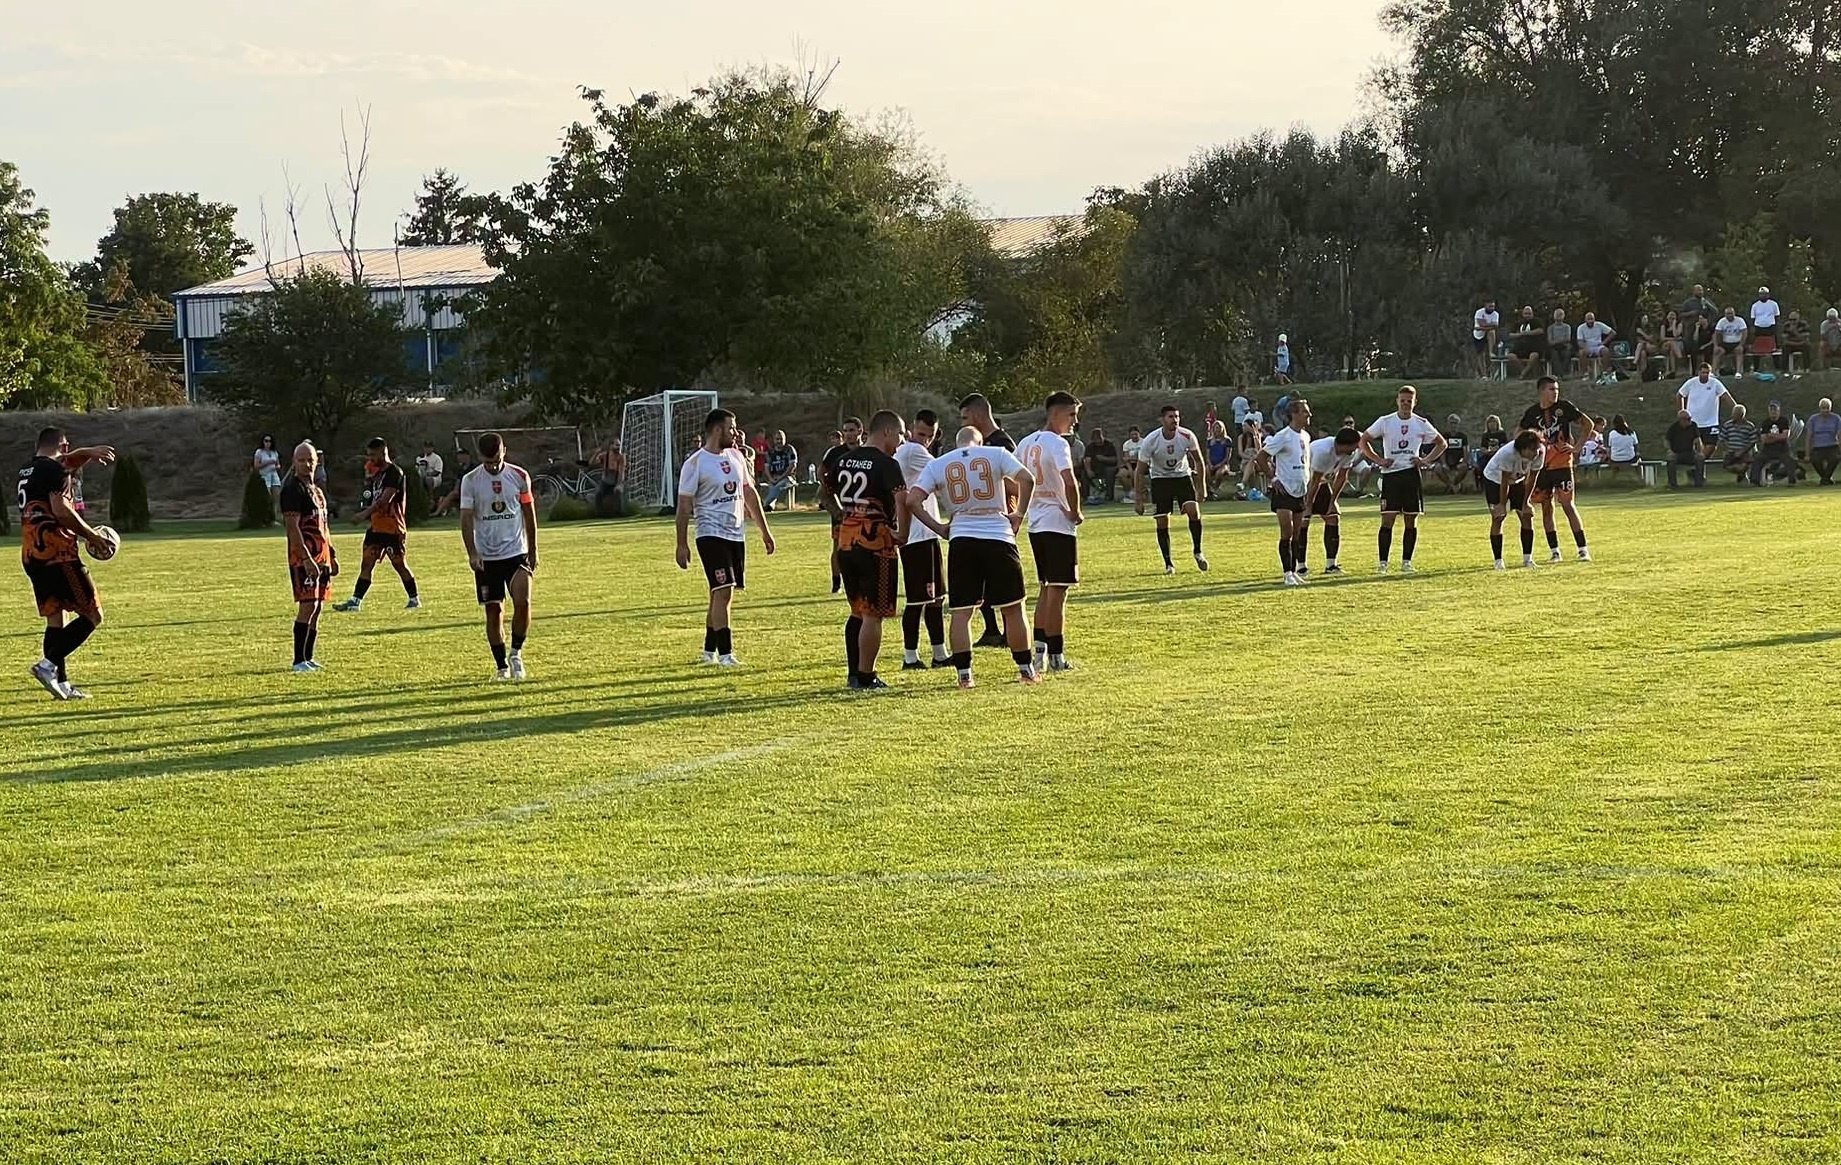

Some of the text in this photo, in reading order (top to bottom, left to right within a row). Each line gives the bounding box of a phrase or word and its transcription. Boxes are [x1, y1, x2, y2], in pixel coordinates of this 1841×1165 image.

[846, 459, 873, 469] СТАНЕВ
[838, 470, 869, 503] 22
[945, 457, 995, 504] 83
[1560, 481, 1573, 490] 18
[18, 479, 28, 509] 5
[304, 577, 315, 587] 4
